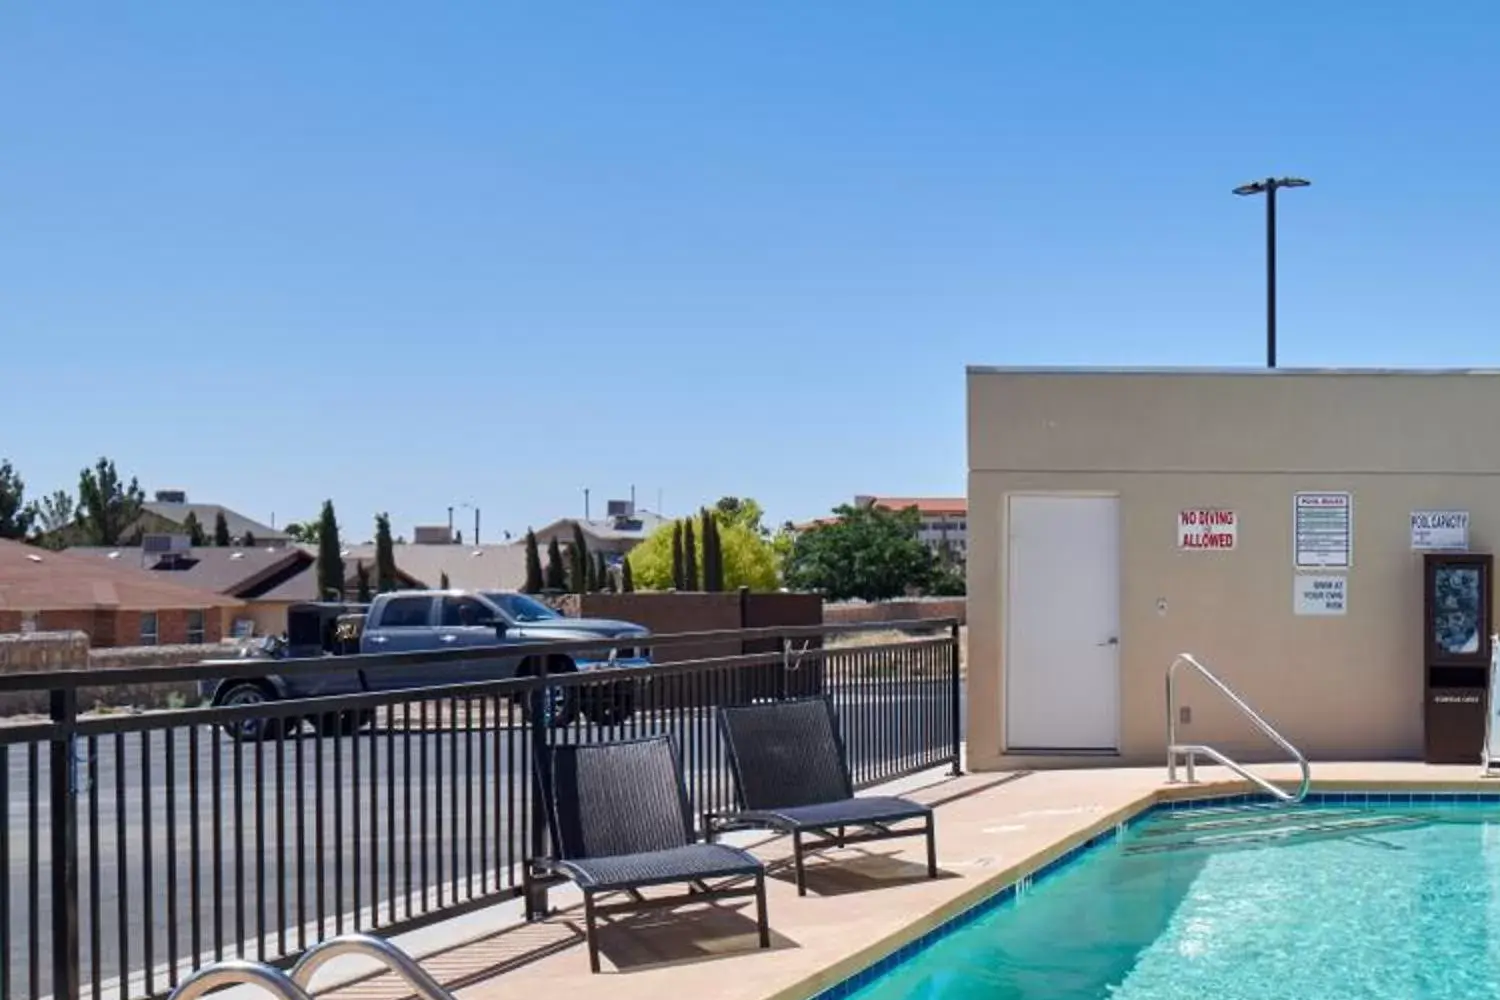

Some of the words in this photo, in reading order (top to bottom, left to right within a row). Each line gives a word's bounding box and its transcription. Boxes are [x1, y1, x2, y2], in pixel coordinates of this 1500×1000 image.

[1181, 511, 1197, 525] NO
[1199, 511, 1233, 525] DIVING
[1411, 515, 1431, 529] POOL
[1431, 514, 1467, 529] CAPACITY
[1183, 533, 1233, 548] ALLOWED
